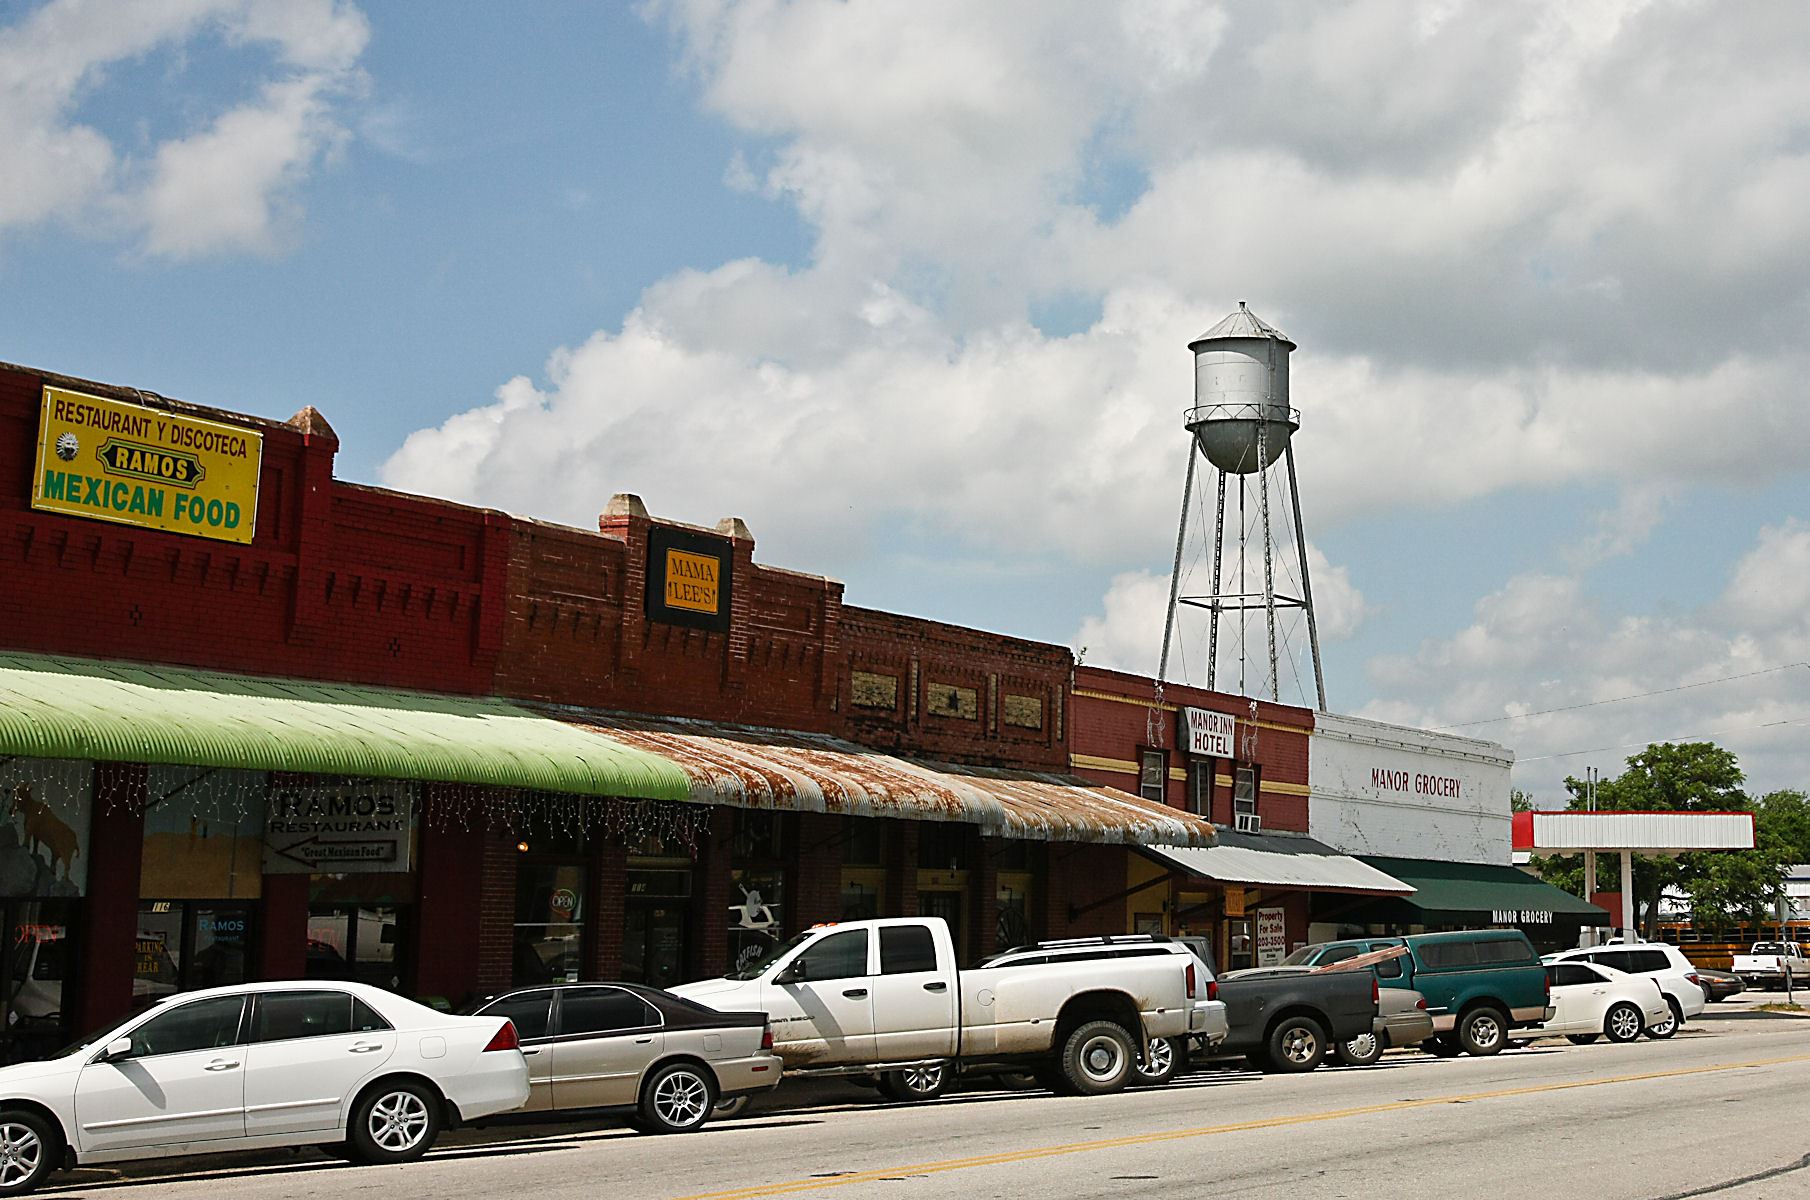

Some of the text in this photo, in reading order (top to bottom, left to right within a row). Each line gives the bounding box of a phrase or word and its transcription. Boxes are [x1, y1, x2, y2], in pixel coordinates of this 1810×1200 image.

[54, 399, 247, 459] RESTAURANT Y DISCOTECA
[115, 447, 188, 480] RAMOS
[44, 469, 240, 529] MEXICAN FOOD
[672, 558, 714, 582] MAMA
[674, 582, 711, 605] LEE'S
[1190, 711, 1234, 735] MANOR INN
[1194, 731, 1228, 754] HOTEL
[1371, 767, 1461, 798] MANOR GROCERY
[279, 793, 395, 817] RAMOS
[271, 820, 403, 833] RESTAURANT
[328, 847, 359, 857] Mexican
[151, 902, 171, 912] 116
[552, 895, 573, 908] OPEN
[200, 919, 245, 932] RAMOS
[1259, 911, 1283, 923] Property
[1492, 910, 1553, 924] MANOR GROCERY
[1259, 924, 1282, 935] For Sale
